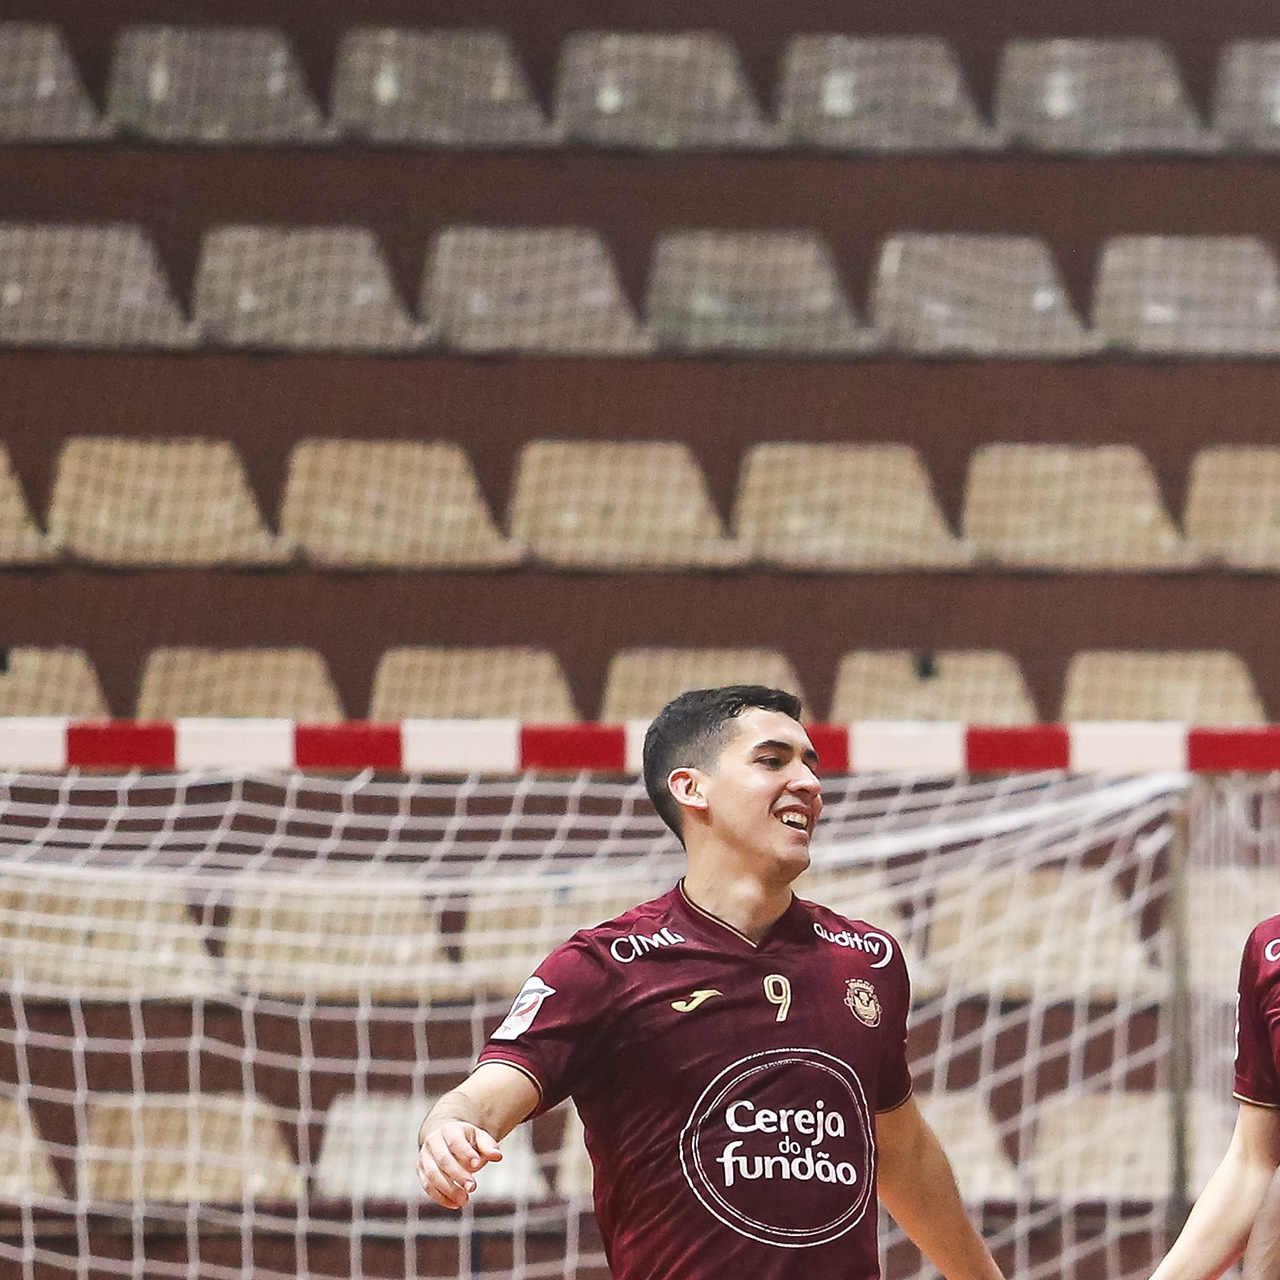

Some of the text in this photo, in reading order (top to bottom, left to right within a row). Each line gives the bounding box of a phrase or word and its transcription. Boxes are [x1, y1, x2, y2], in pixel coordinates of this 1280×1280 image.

[813, 923, 881, 956] auditiv
[763, 974, 792, 1022] 9
[724, 1100, 845, 1145] Cereja
[778, 1135, 801, 1154] do
[716, 1141, 858, 1186] fundão
